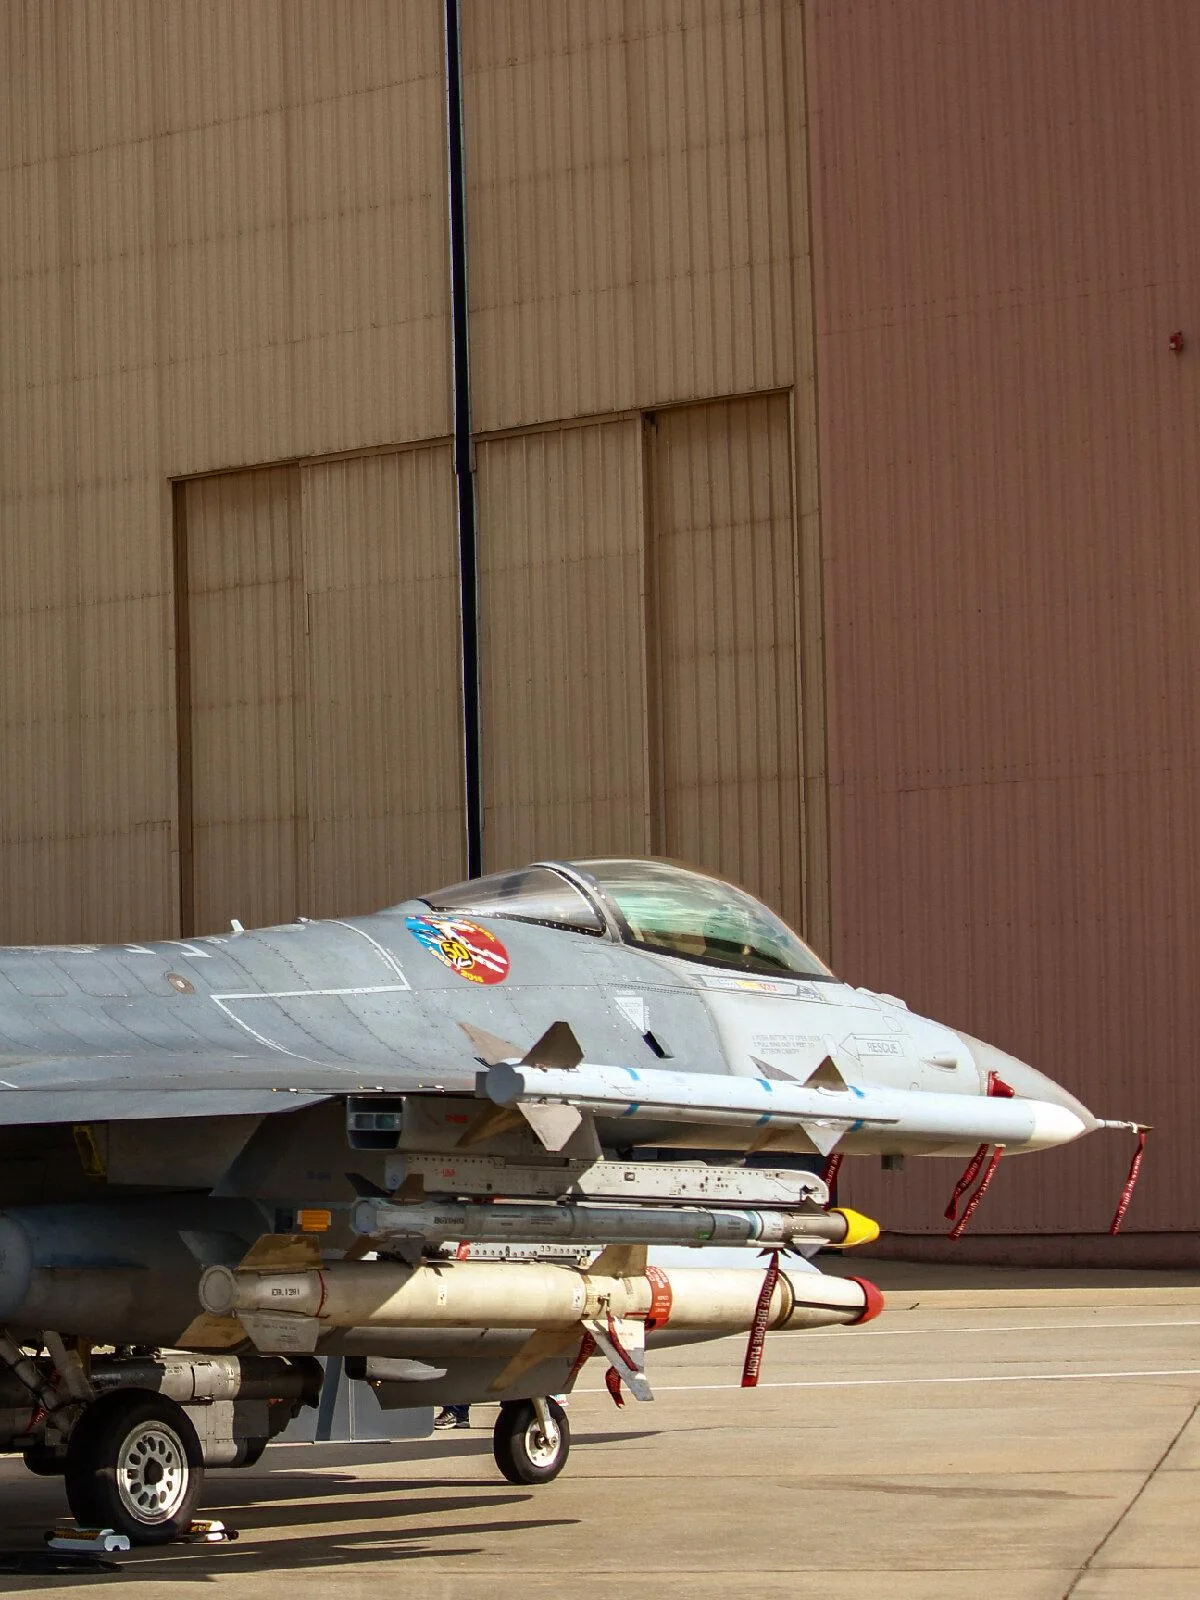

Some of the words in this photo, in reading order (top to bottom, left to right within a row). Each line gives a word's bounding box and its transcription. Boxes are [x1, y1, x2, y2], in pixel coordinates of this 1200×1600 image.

[443, 941, 470, 960] 50
[866, 1042, 899, 1055] RESCUE
[760, 1269, 778, 1309] REMOVE
[752, 1310, 769, 1345] BEFORE
[746, 1345, 762, 1377] FLIGHT
